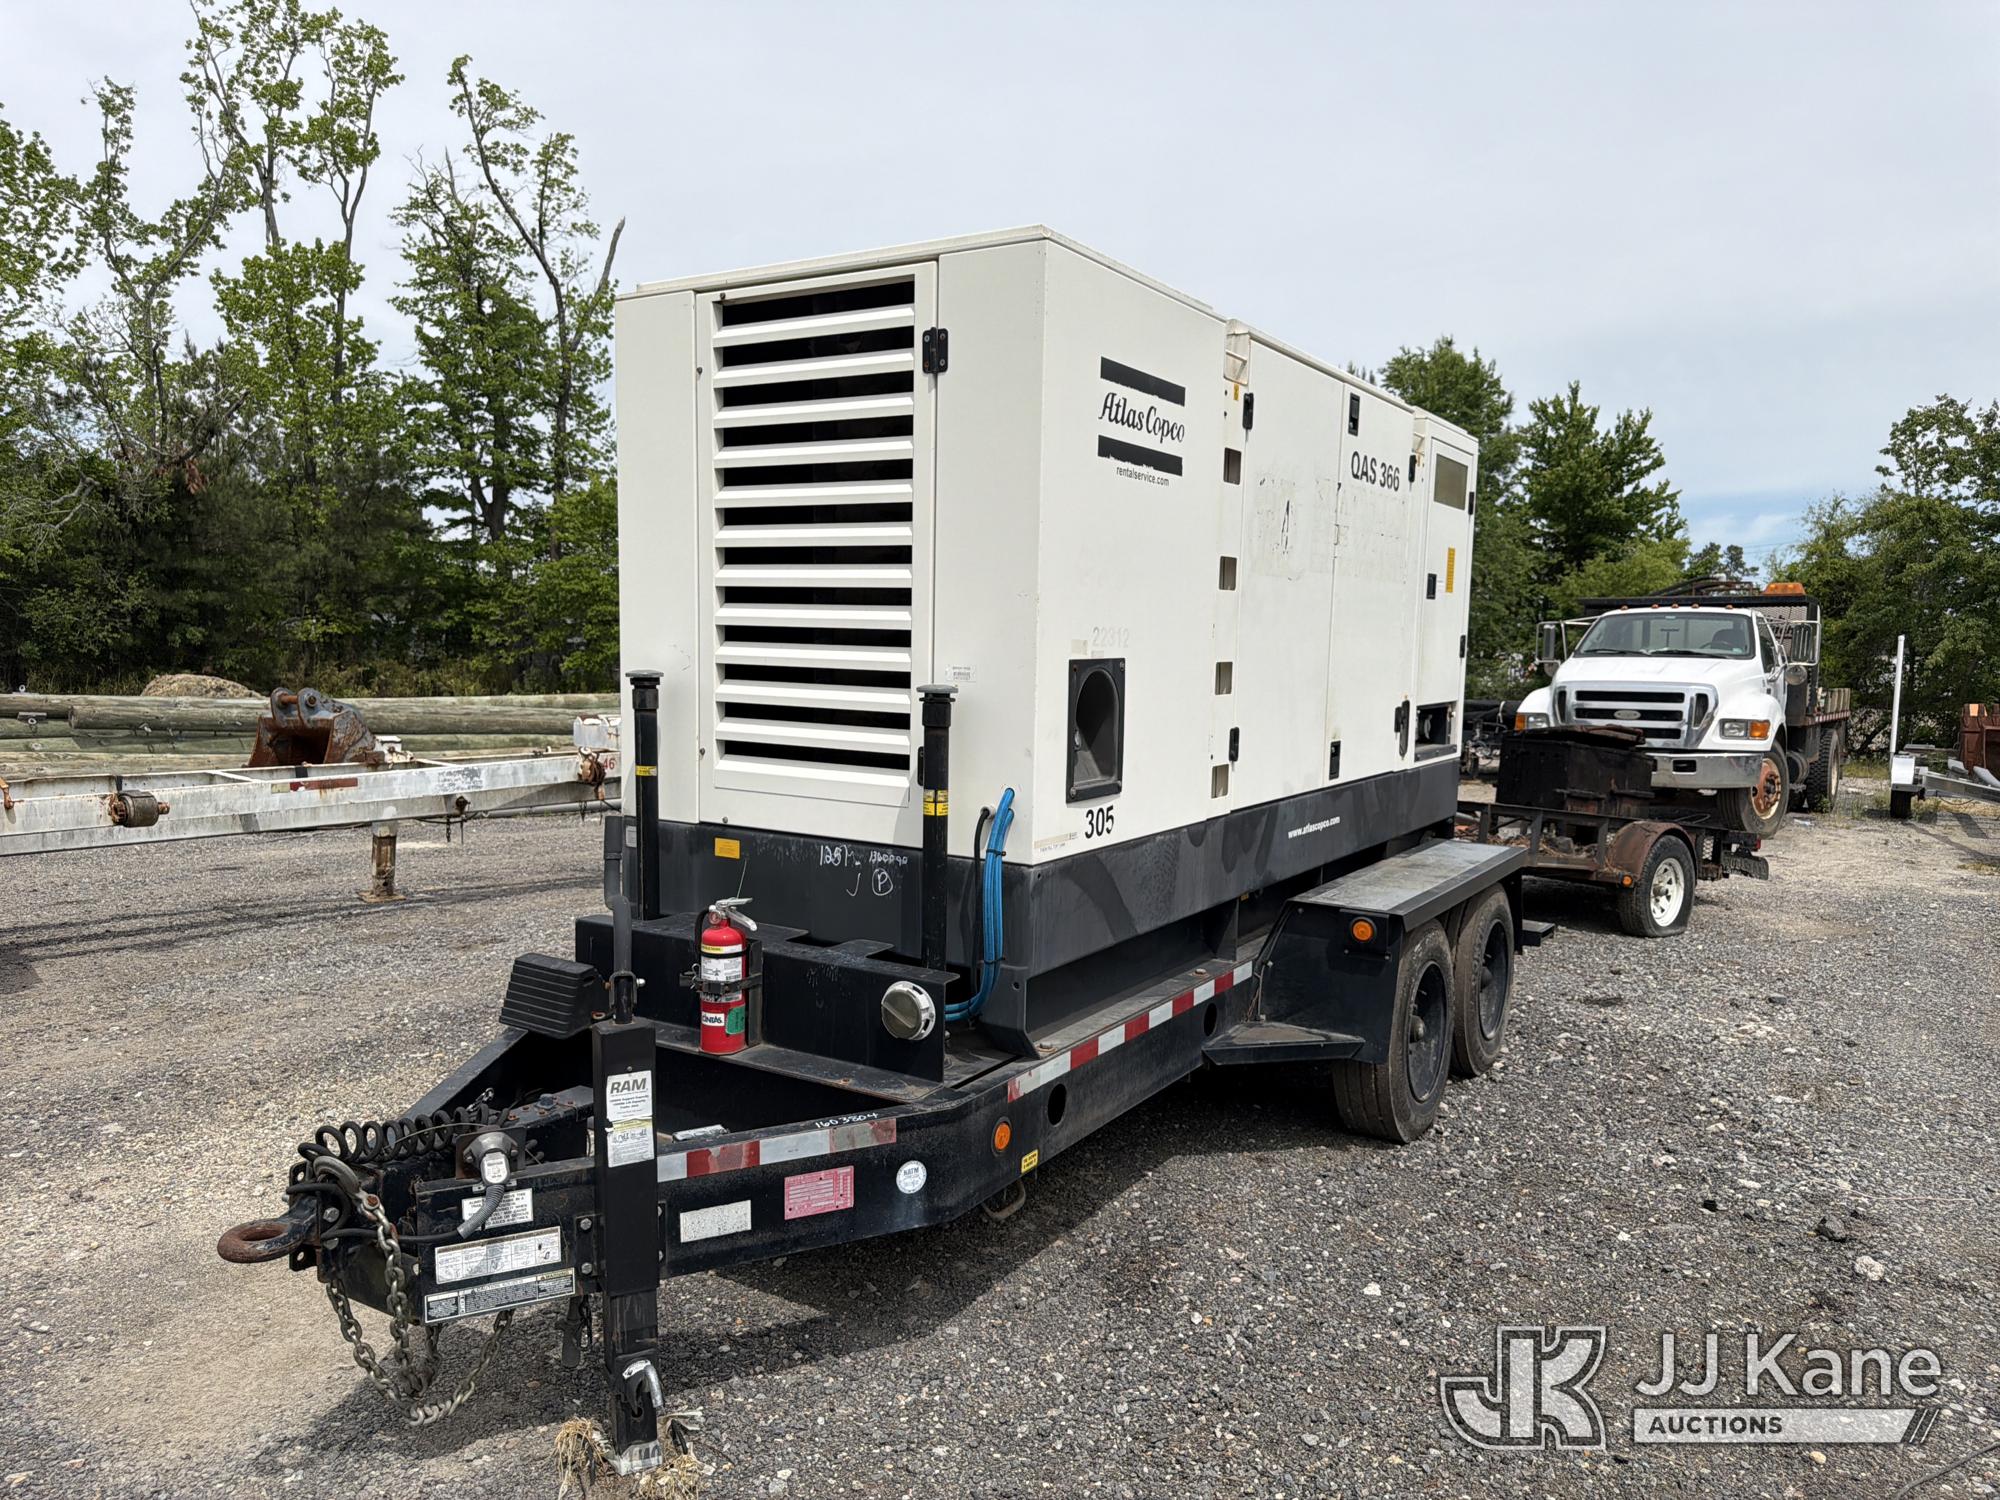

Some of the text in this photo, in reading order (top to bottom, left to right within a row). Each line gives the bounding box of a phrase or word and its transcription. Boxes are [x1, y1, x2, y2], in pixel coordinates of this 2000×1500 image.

[1098, 391, 1185, 443] Atlas Copco
[1116, 466, 1170, 486] rentalservice.com
[1351, 450, 1400, 492] QAS 366
[1084, 805, 1114, 839] 305
[610, 1077, 647, 1094] RAM
